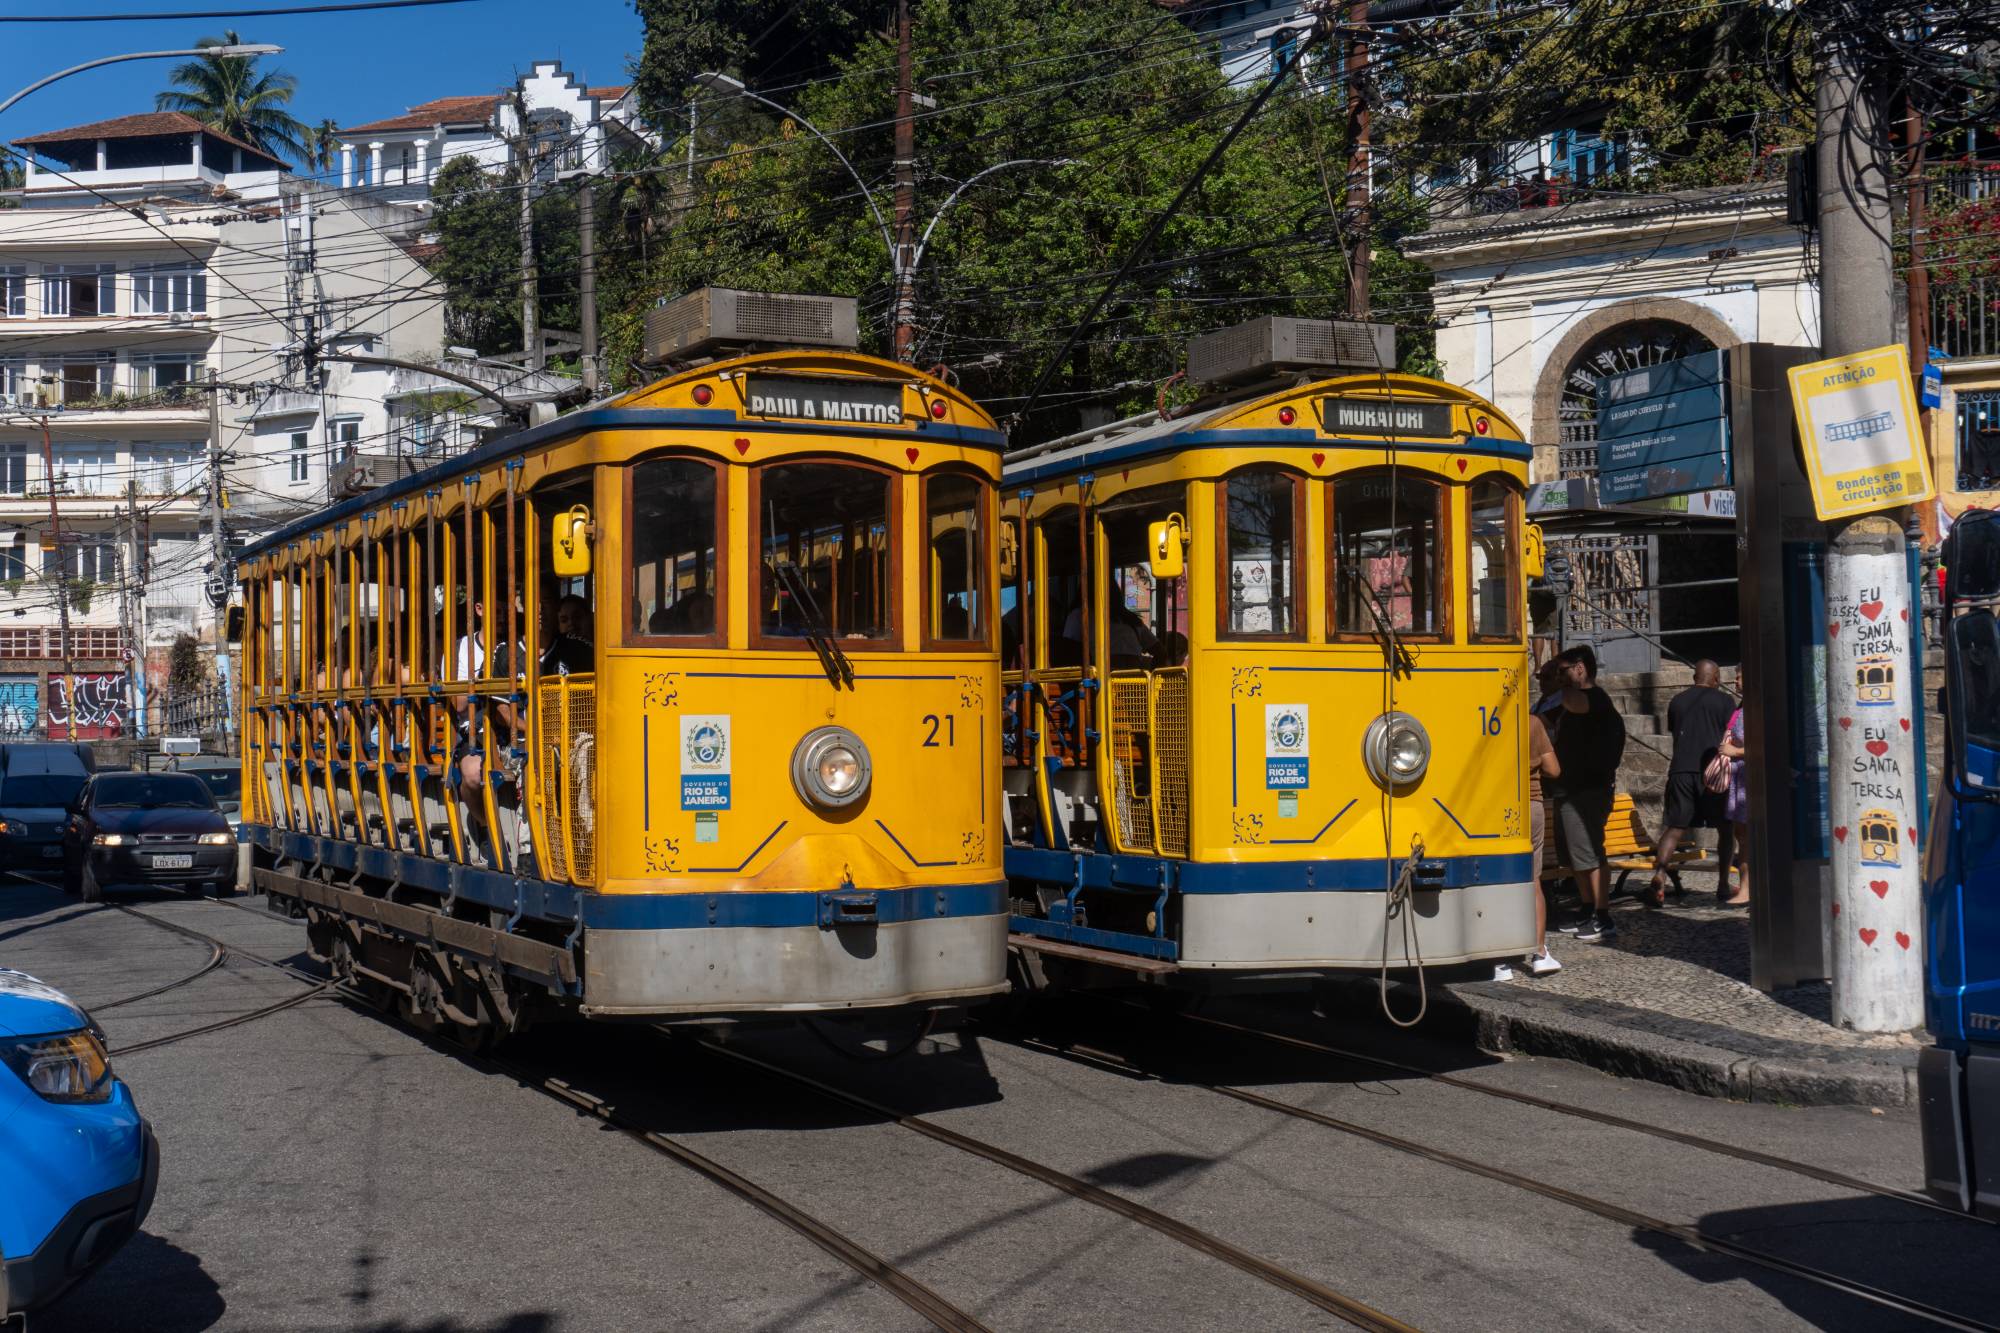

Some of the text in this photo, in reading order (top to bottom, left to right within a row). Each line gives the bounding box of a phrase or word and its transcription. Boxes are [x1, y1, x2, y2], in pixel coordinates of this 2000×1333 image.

[1823, 366, 1876, 387] ATENÇÃO
[822, 400, 901, 424] MATTOS
[1339, 404, 1424, 429] MURATORI
[1836, 471, 1901, 491] Bondes em
[1842, 482, 1903, 502] circulação
[1860, 586, 1880, 603] EU
[1857, 621, 1893, 641] SANTA
[1852, 638, 1896, 657] TERESA
[922, 714, 954, 747] 21
[1478, 706, 1501, 736] 16
[1864, 727, 1886, 740] EU
[1268, 768, 1298, 776] RIO DE
[1852, 755, 1901, 777] SANTA
[1268, 776, 1306, 785] JANEIRO
[684, 786, 719, 796] RIO DE
[684, 796, 728, 805] JANEIRO
[1851, 782, 1904, 807] TERESA
